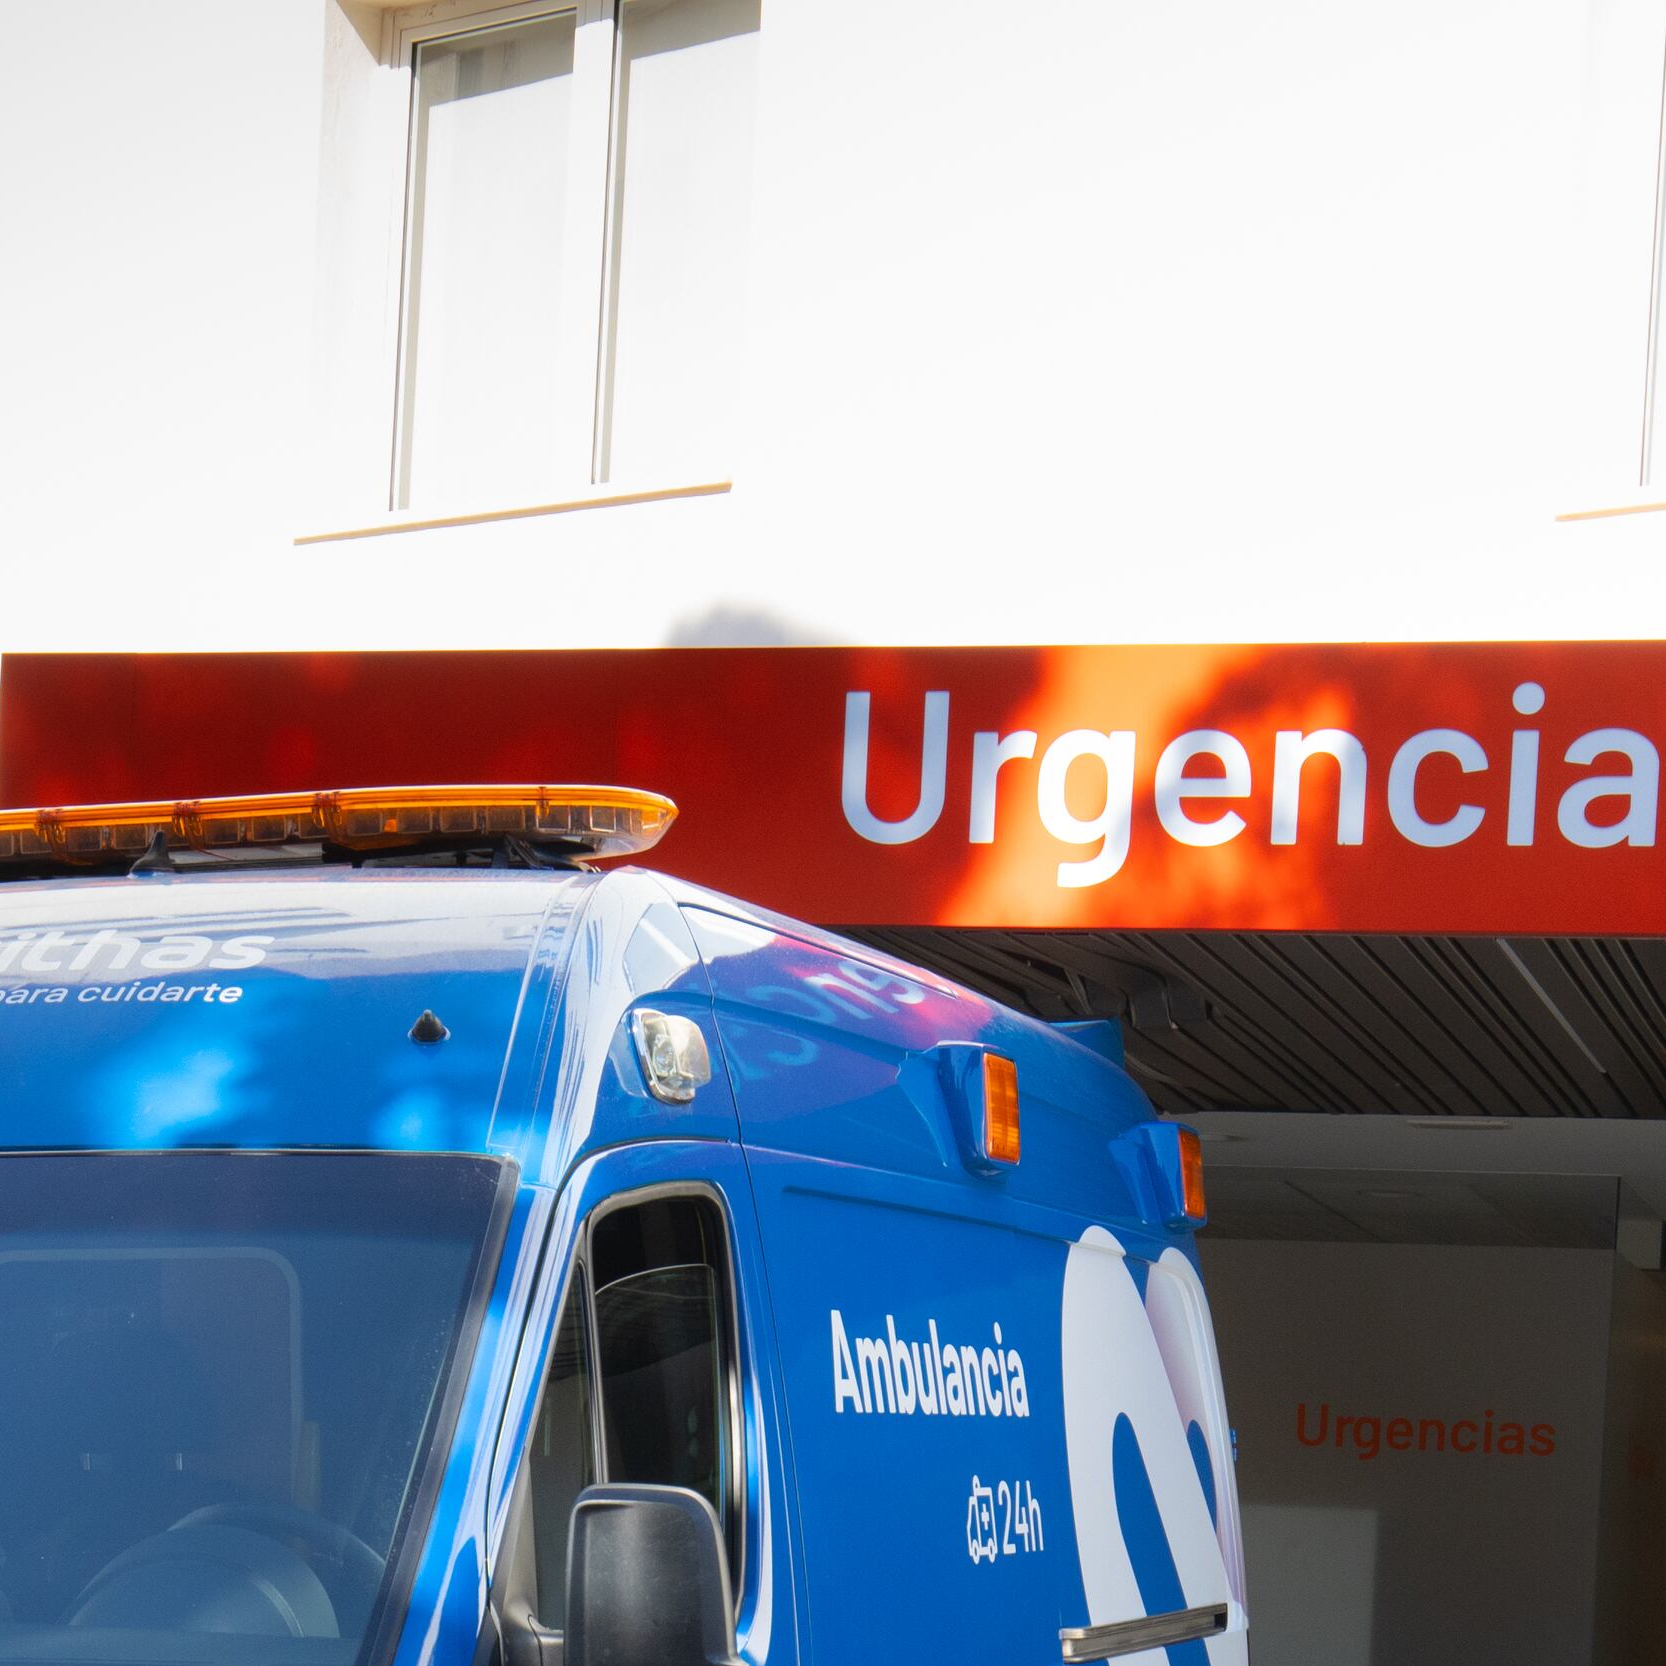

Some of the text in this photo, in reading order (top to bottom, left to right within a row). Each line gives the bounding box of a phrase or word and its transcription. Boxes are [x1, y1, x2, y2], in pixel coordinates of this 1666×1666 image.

[76, 980, 244, 1004] cuidarte
[831, 1310, 1029, 1418] Ambulancia
[1296, 1402, 1557, 1461] Urgencias
[997, 1480, 1043, 1554] 24h
